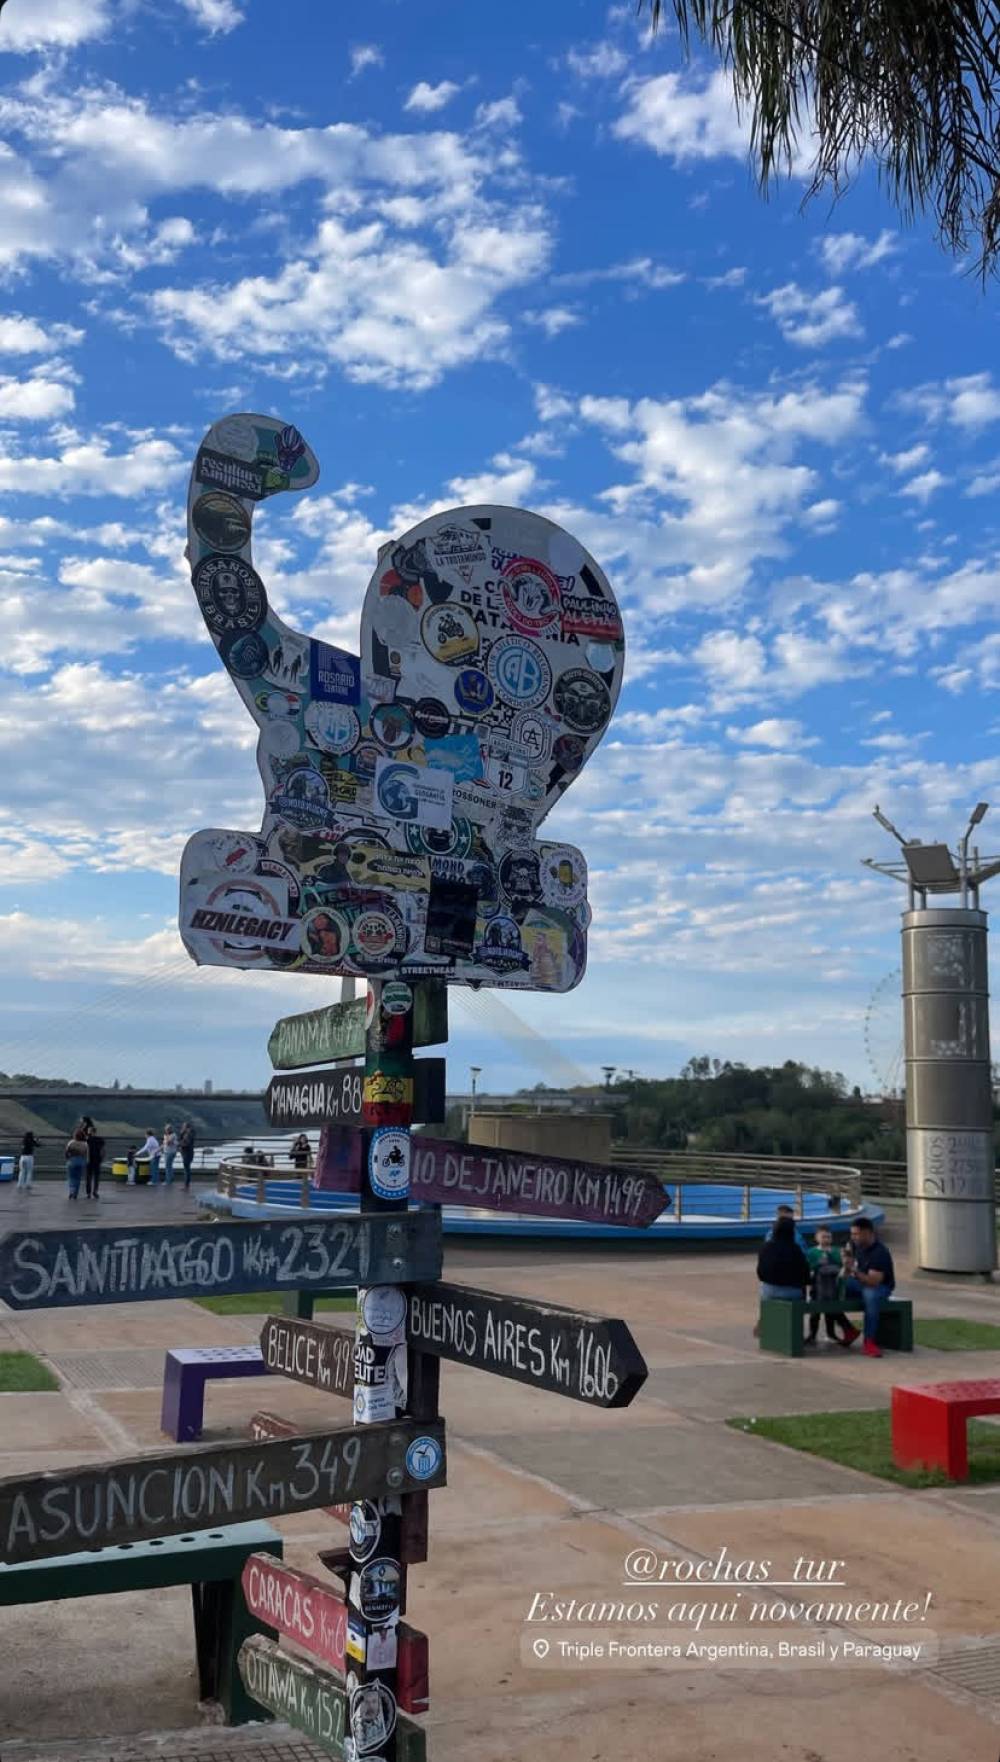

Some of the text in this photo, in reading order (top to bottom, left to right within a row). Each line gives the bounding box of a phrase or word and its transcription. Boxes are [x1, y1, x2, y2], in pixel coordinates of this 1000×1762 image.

[498, 770, 513, 790] 12
[270, 1082, 325, 1117] MANAGUA
[413, 1151, 436, 1185] IO
[444, 1156, 474, 1191] DE
[474, 1157, 568, 1205] JANEIRO
[276, 1221, 371, 1282] 2321
[267, 1324, 317, 1379] BELICE
[410, 1296, 476, 1357] BUENOS
[483, 1309, 546, 1377] AIRES
[7, 1461, 235, 1552] ASUNCION
[288, 1436, 362, 1501] 349
[249, 1566, 315, 1638] CARACAS
[246, 1647, 298, 1713] OTTAWA
